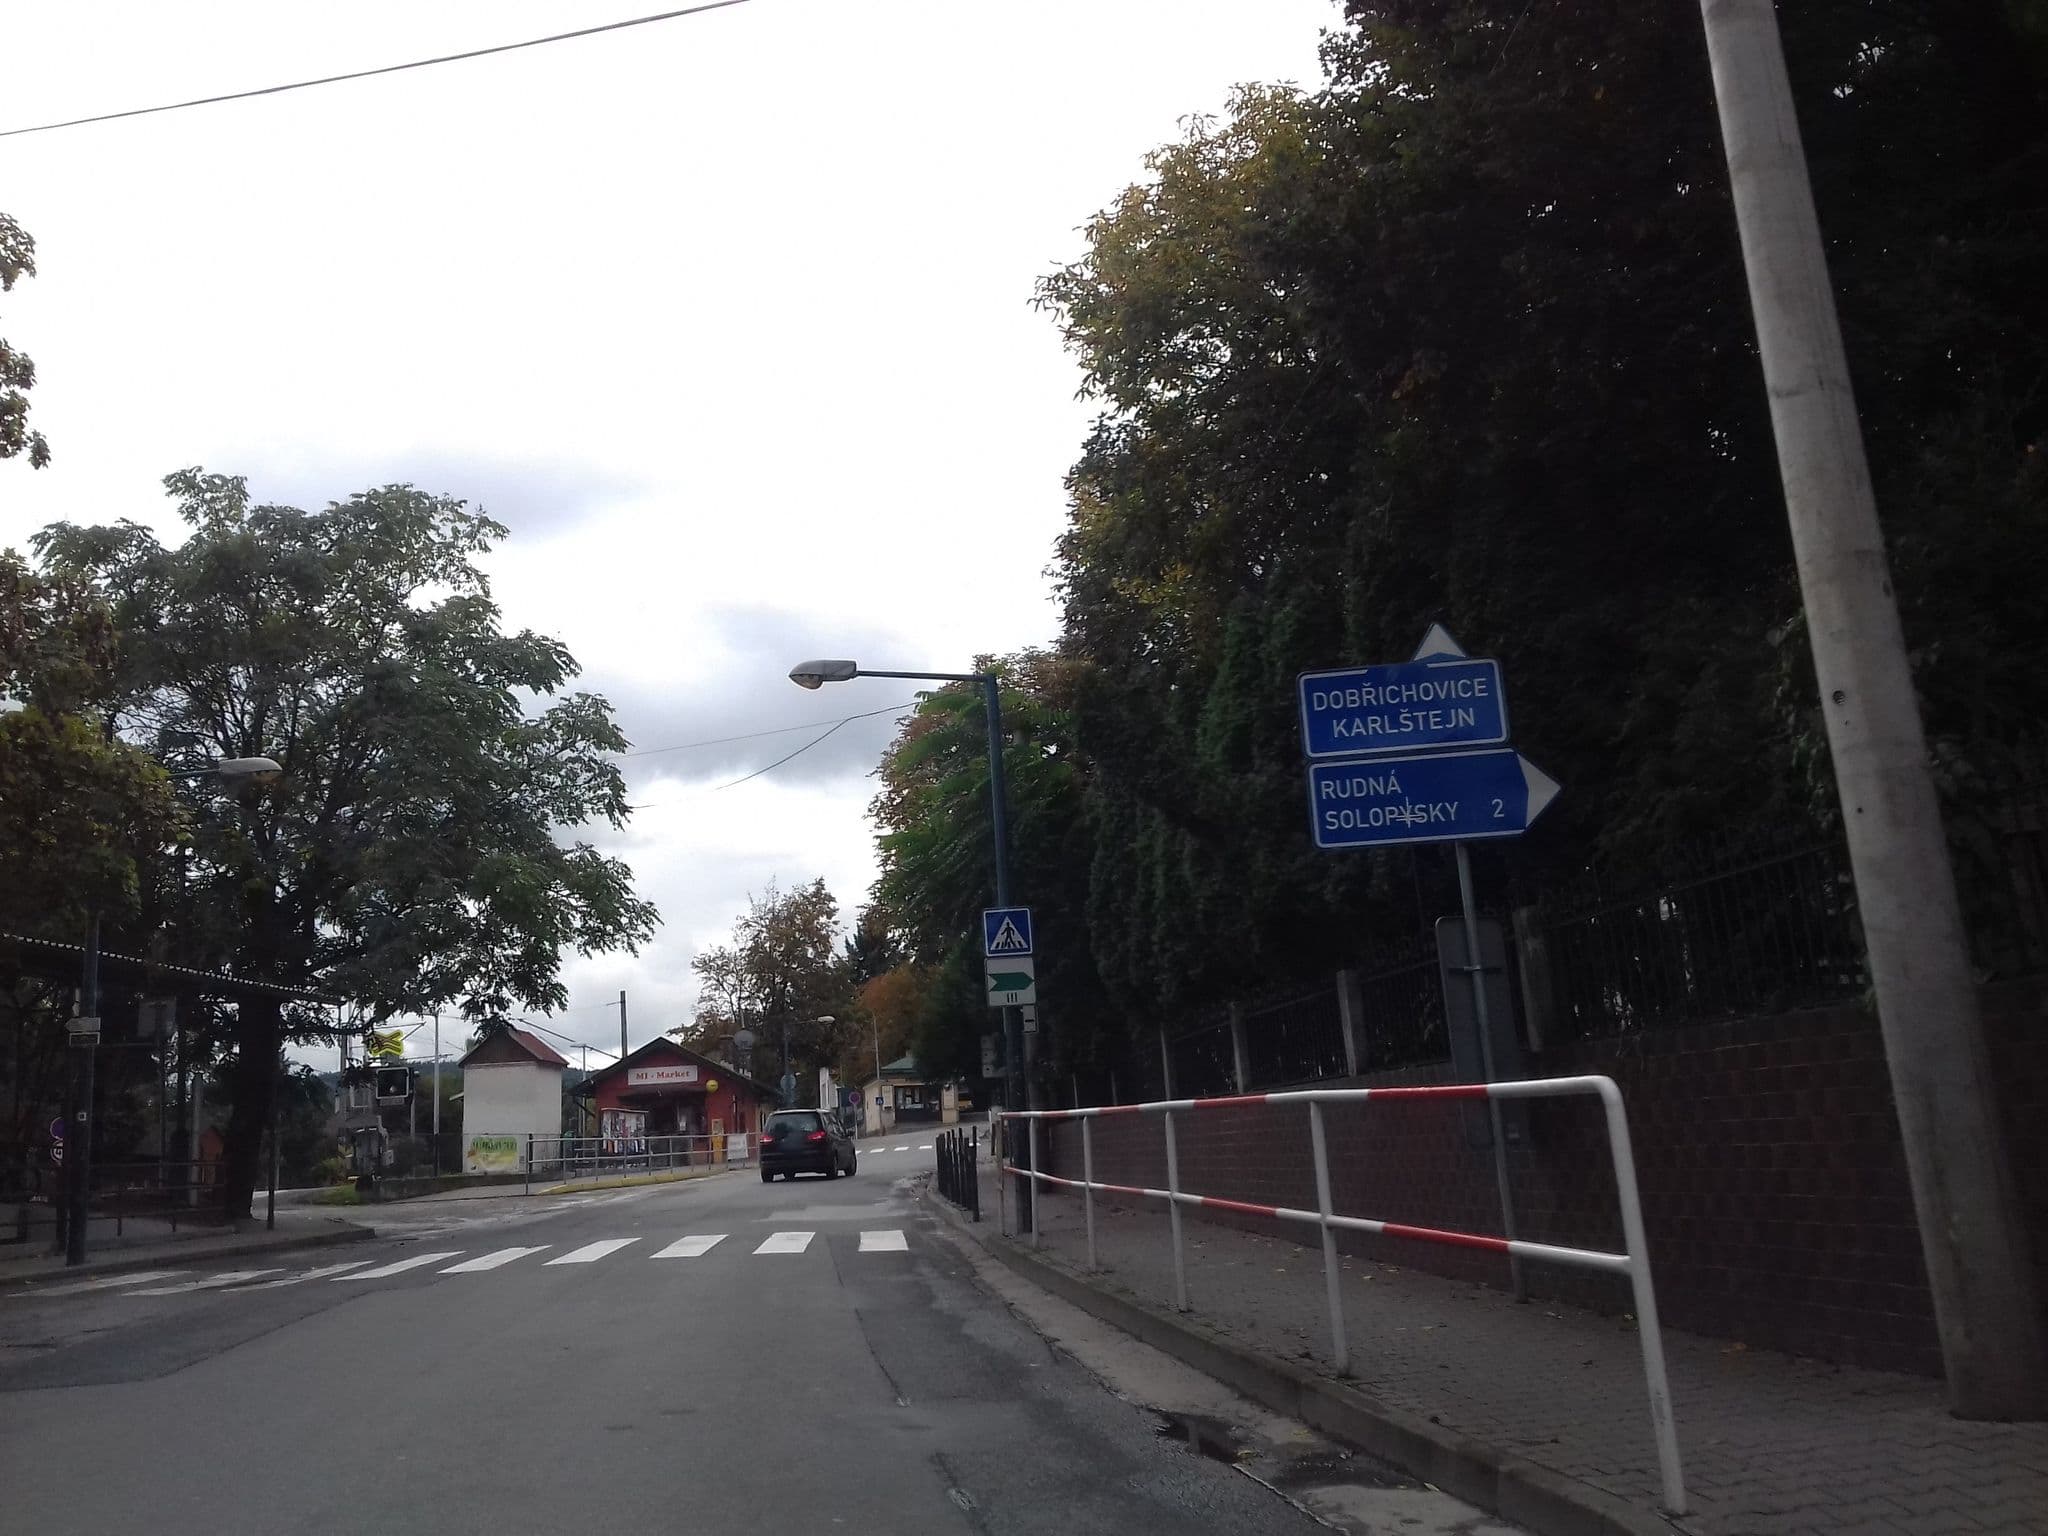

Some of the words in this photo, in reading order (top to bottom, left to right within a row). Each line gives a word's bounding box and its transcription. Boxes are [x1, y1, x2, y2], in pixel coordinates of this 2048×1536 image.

[1313, 678, 1489, 711] DOBŘICHOVICE
[1333, 708, 1475, 738] KARLŠTEJN
[1321, 769, 1402, 799] RUDNÁ
[1491, 799, 1505, 818] 2
[656, 1070, 690, 1079] Market
